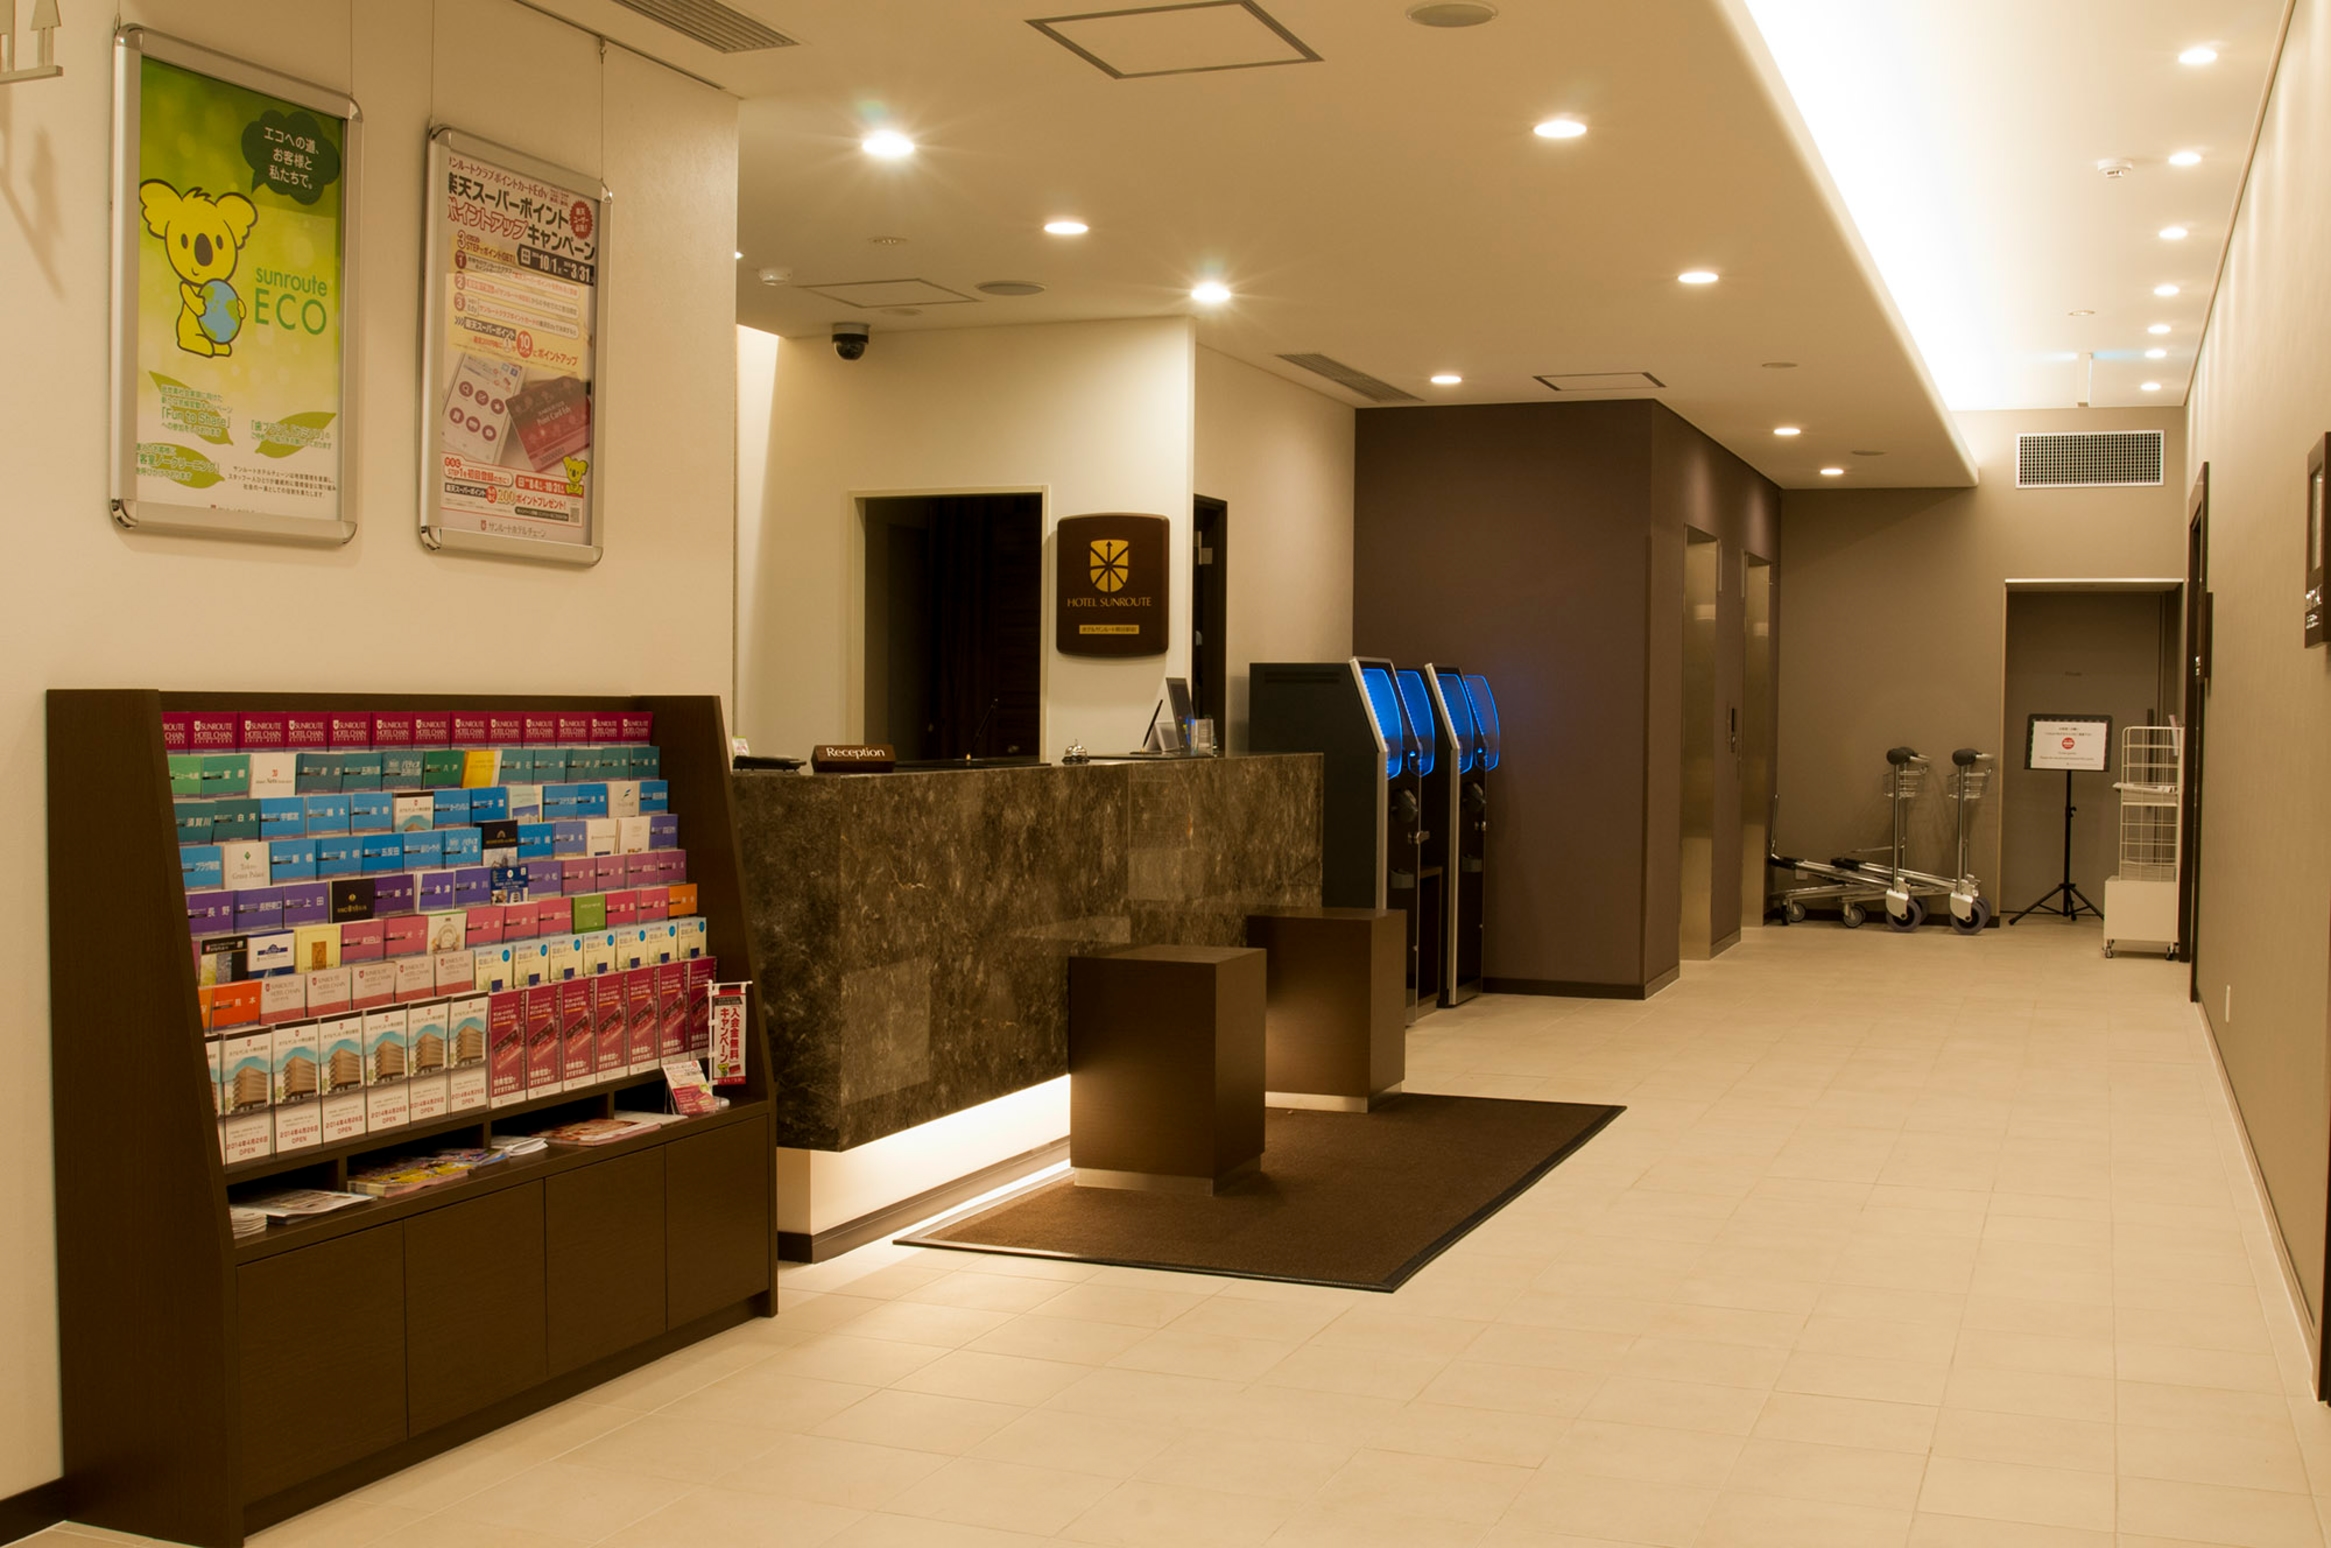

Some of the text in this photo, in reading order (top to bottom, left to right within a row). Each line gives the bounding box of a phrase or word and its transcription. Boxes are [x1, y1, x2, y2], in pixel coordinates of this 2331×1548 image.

[264, 127, 319, 154] エコへの道、
[272, 148, 313, 171] お客様と
[269, 164, 313, 190] 私たちで。
[447, 196, 529, 240] ポイントアップ
[527, 224, 595, 261] キャンペーン
[255, 267, 327, 297] sunroute
[254, 288, 328, 335] ECO
[1067, 597, 1151, 607] HOTEL SUNROUTE
[163, 723, 185, 731] ROUTE
[200, 722, 232, 731] SUNROUTE
[826, 747, 885, 760] Reception
[719, 1007, 730, 1064] キャンペーン
[462, 1098, 475, 1106] OPEN
[382, 1116, 396, 1124] OPEN
[337, 1126, 352, 1134] OPEN
[291, 1136, 307, 1144] OPEN
[239, 1147, 256, 1156] OPEN
